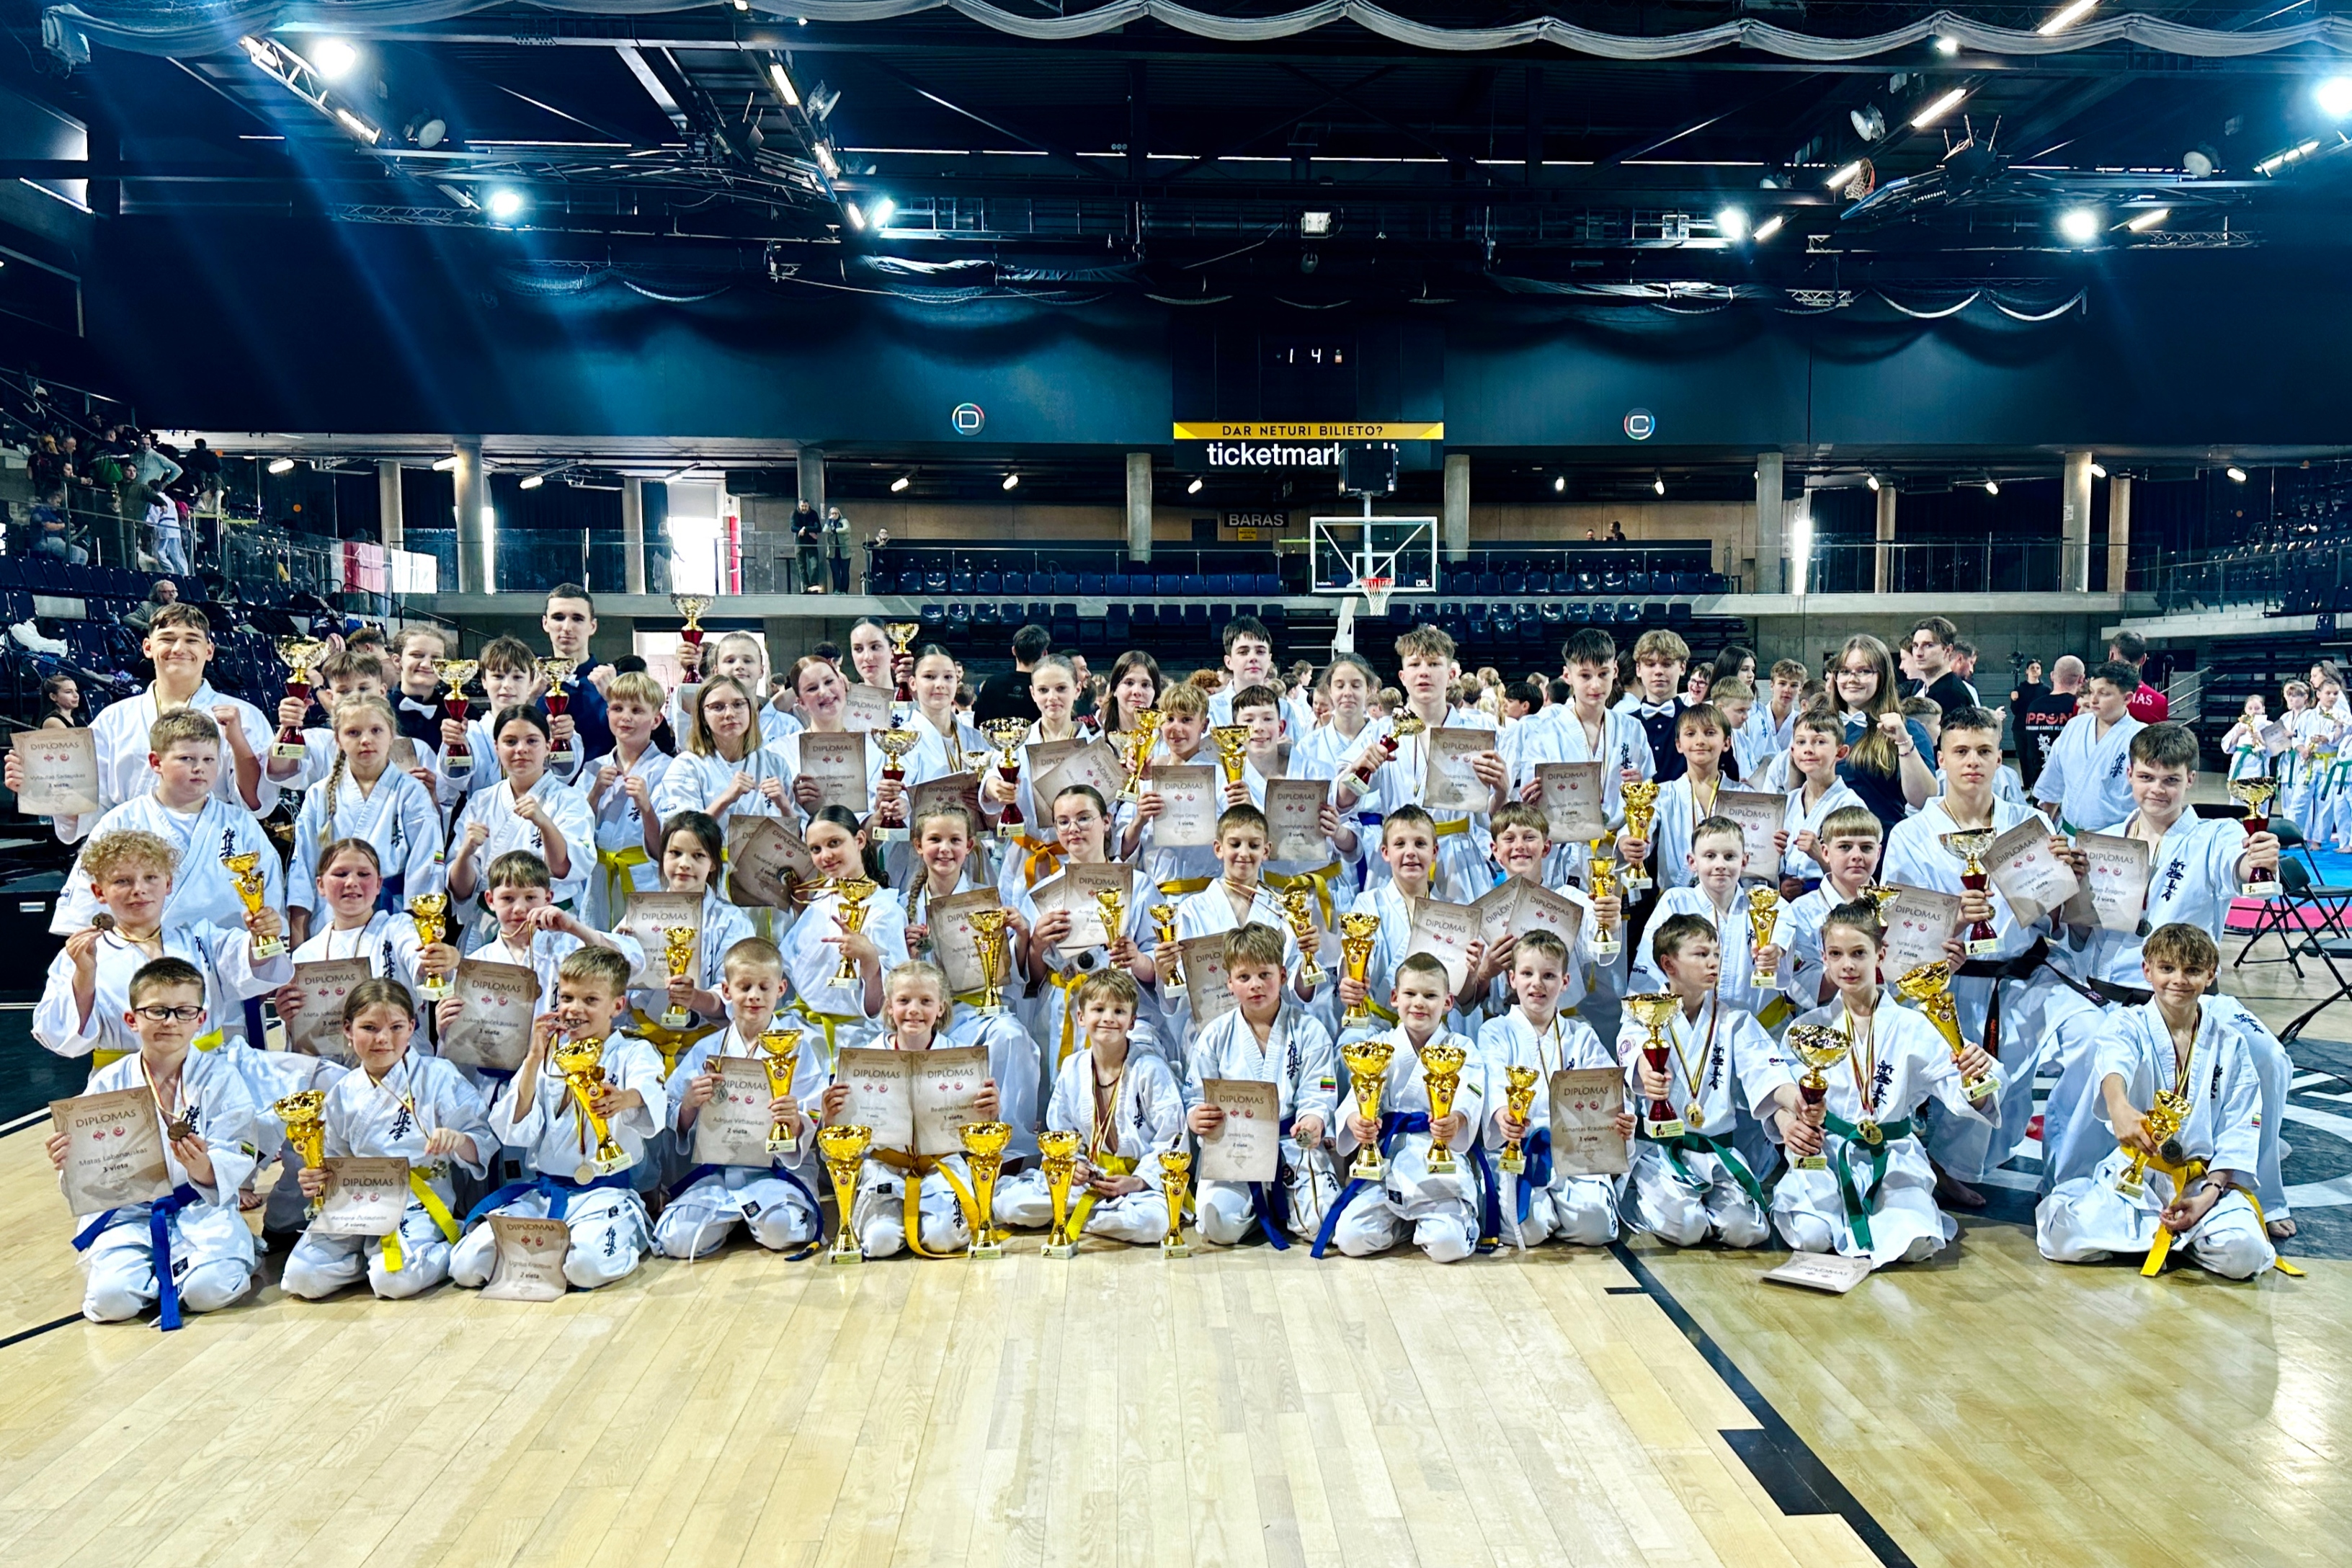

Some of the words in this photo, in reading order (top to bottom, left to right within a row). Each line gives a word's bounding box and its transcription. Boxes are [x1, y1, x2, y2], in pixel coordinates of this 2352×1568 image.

[1311, 348, 1322, 363] 4
[1222, 426, 1252, 436] DAR
[1260, 426, 1311, 436] NETURI
[1319, 425, 1383, 436] BILIETO?
[1229, 513, 1284, 526] BARAS
[30, 741, 79, 750] DIPLOMAS
[1443, 741, 1482, 751] DIPLOMAS
[1041, 757, 1065, 766] DIPLO
[1090, 754, 1115, 789] DIPLOMAS
[1547, 772, 1587, 780] DIPLOMAS
[928, 783, 966, 793] DIPLOMAS
[1729, 808, 1771, 819] DIPLOMAS
[772, 829, 808, 855] DIPLOMAS
[1996, 836, 2038, 864] DIPLOMAS
[2089, 852, 2134, 864] DIPLOMAS
[1079, 877, 1119, 886] DIPLOMAS
[2035, 880, 2049, 890] vieta
[1530, 895, 1569, 917] DIPLOMAS
[641, 912, 688, 921] DIPLOMAS
[948, 912, 970, 923] DIPLO
[1485, 900, 1515, 924] DIPLOM
[1895, 904, 1942, 922] DIPLOMAS
[1425, 918, 1466, 933] DIPLOMAS
[1196, 951, 1222, 963] DIPLO
[1903, 950, 1918, 959] vieta
[305, 974, 356, 985] DIPLOMAS
[472, 979, 521, 993] DIPLOMAS
[853, 1069, 900, 1079] DIPLOMAS
[927, 1068, 974, 1079] DIPLOMAS
[721, 1080, 768, 1091] DIPLOMAS
[1564, 1086, 1609, 1097] DIPLOMAS
[1219, 1095, 1265, 1105] DIPLOMAS
[76, 1108, 137, 1128] DIPLOMAS
[79, 1157, 102, 1167] Matas
[103, 1146, 148, 1162] Labanauskas
[342, 1177, 393, 1187] DIPLOMAS
[1799, 1264, 1849, 1276] DIPLOMAS
